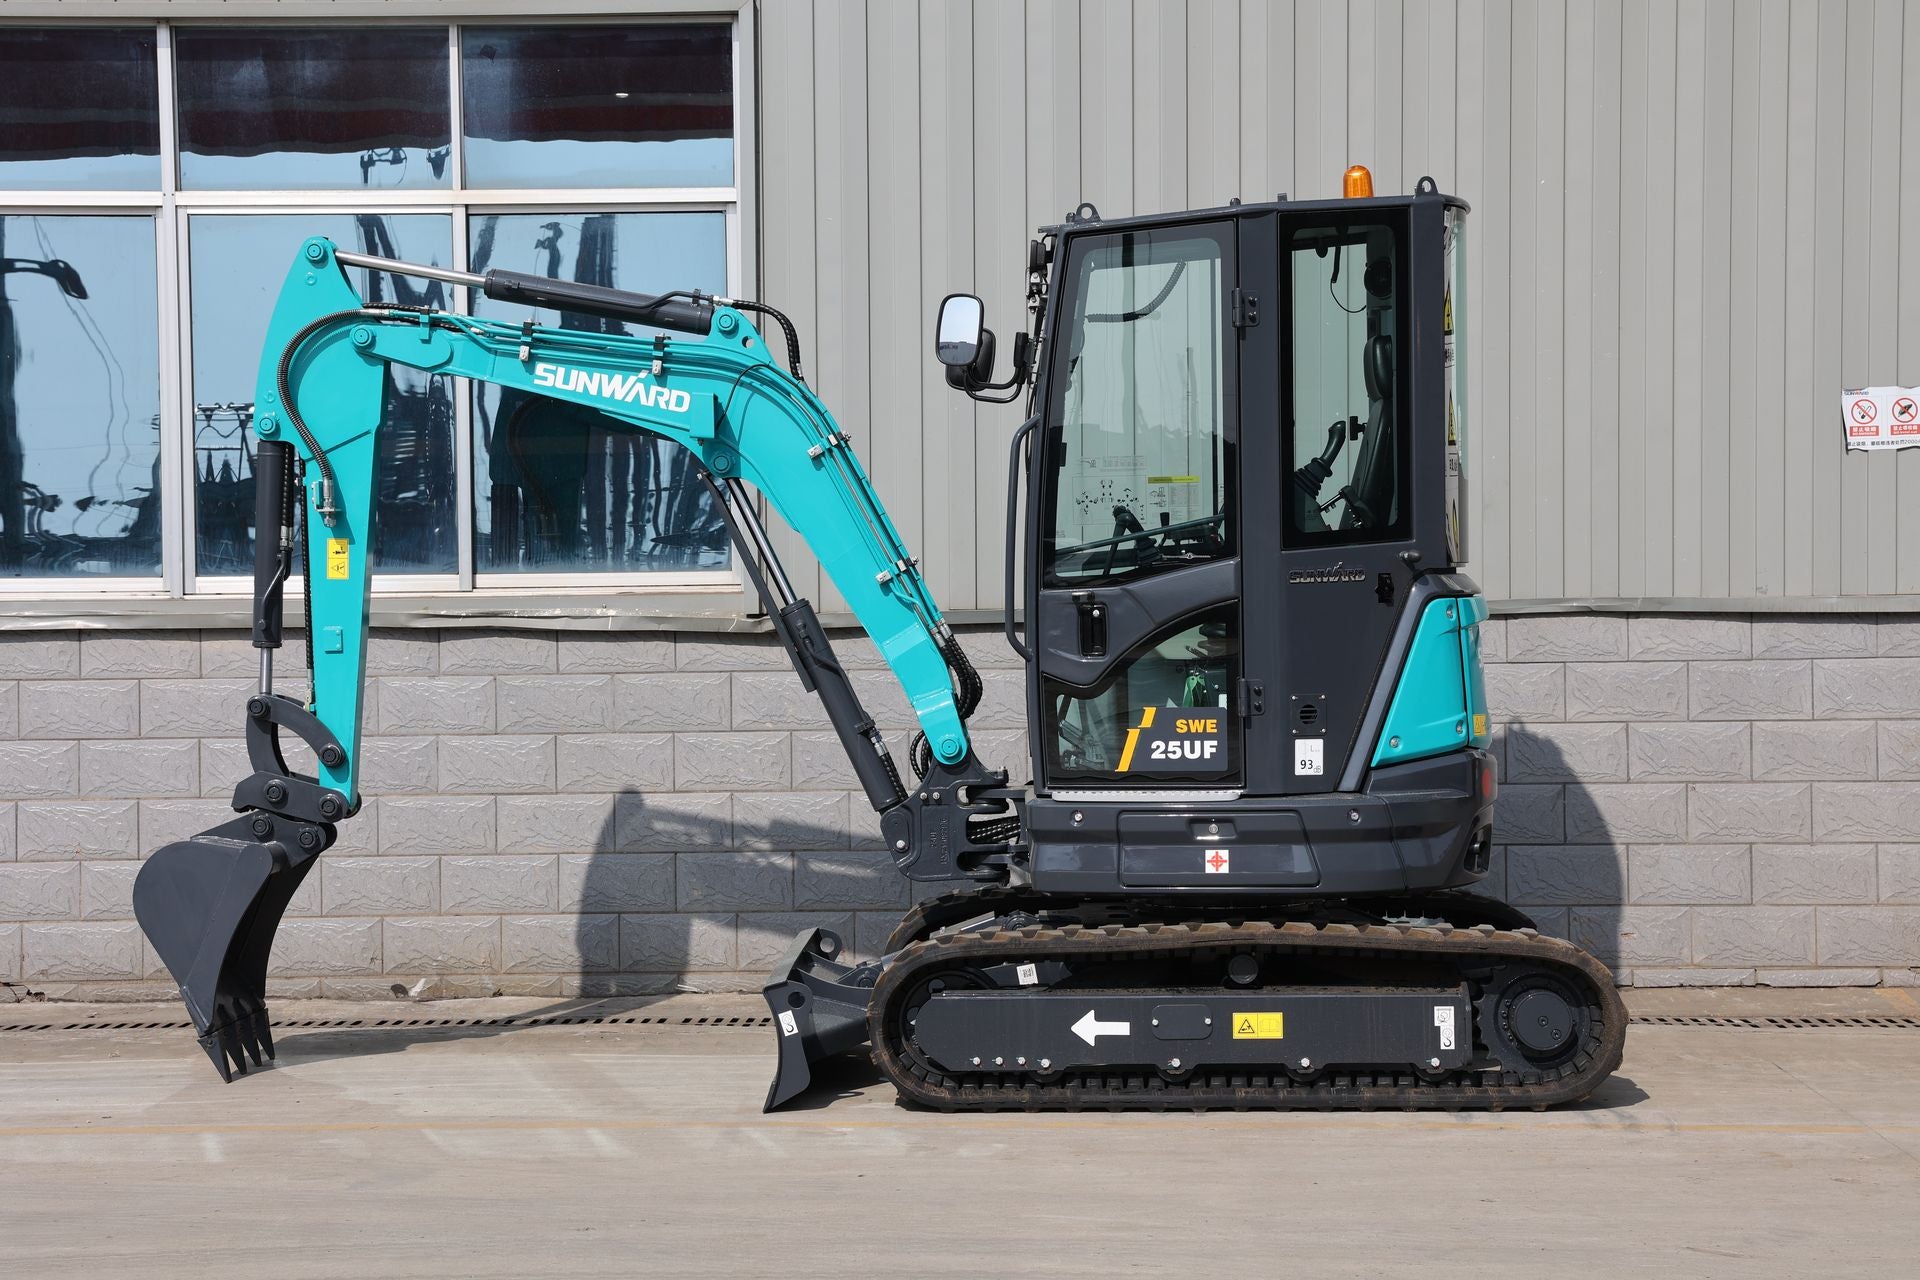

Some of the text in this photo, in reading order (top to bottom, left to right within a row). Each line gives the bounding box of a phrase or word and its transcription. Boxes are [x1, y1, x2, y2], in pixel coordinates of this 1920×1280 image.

[533, 362, 691, 412] SUNWARD
[1288, 561, 1366, 584] SUNWARD
[1175, 718, 1218, 734] SWE
[1150, 739, 1218, 760] 25UF
[1300, 759, 1314, 770] 93
